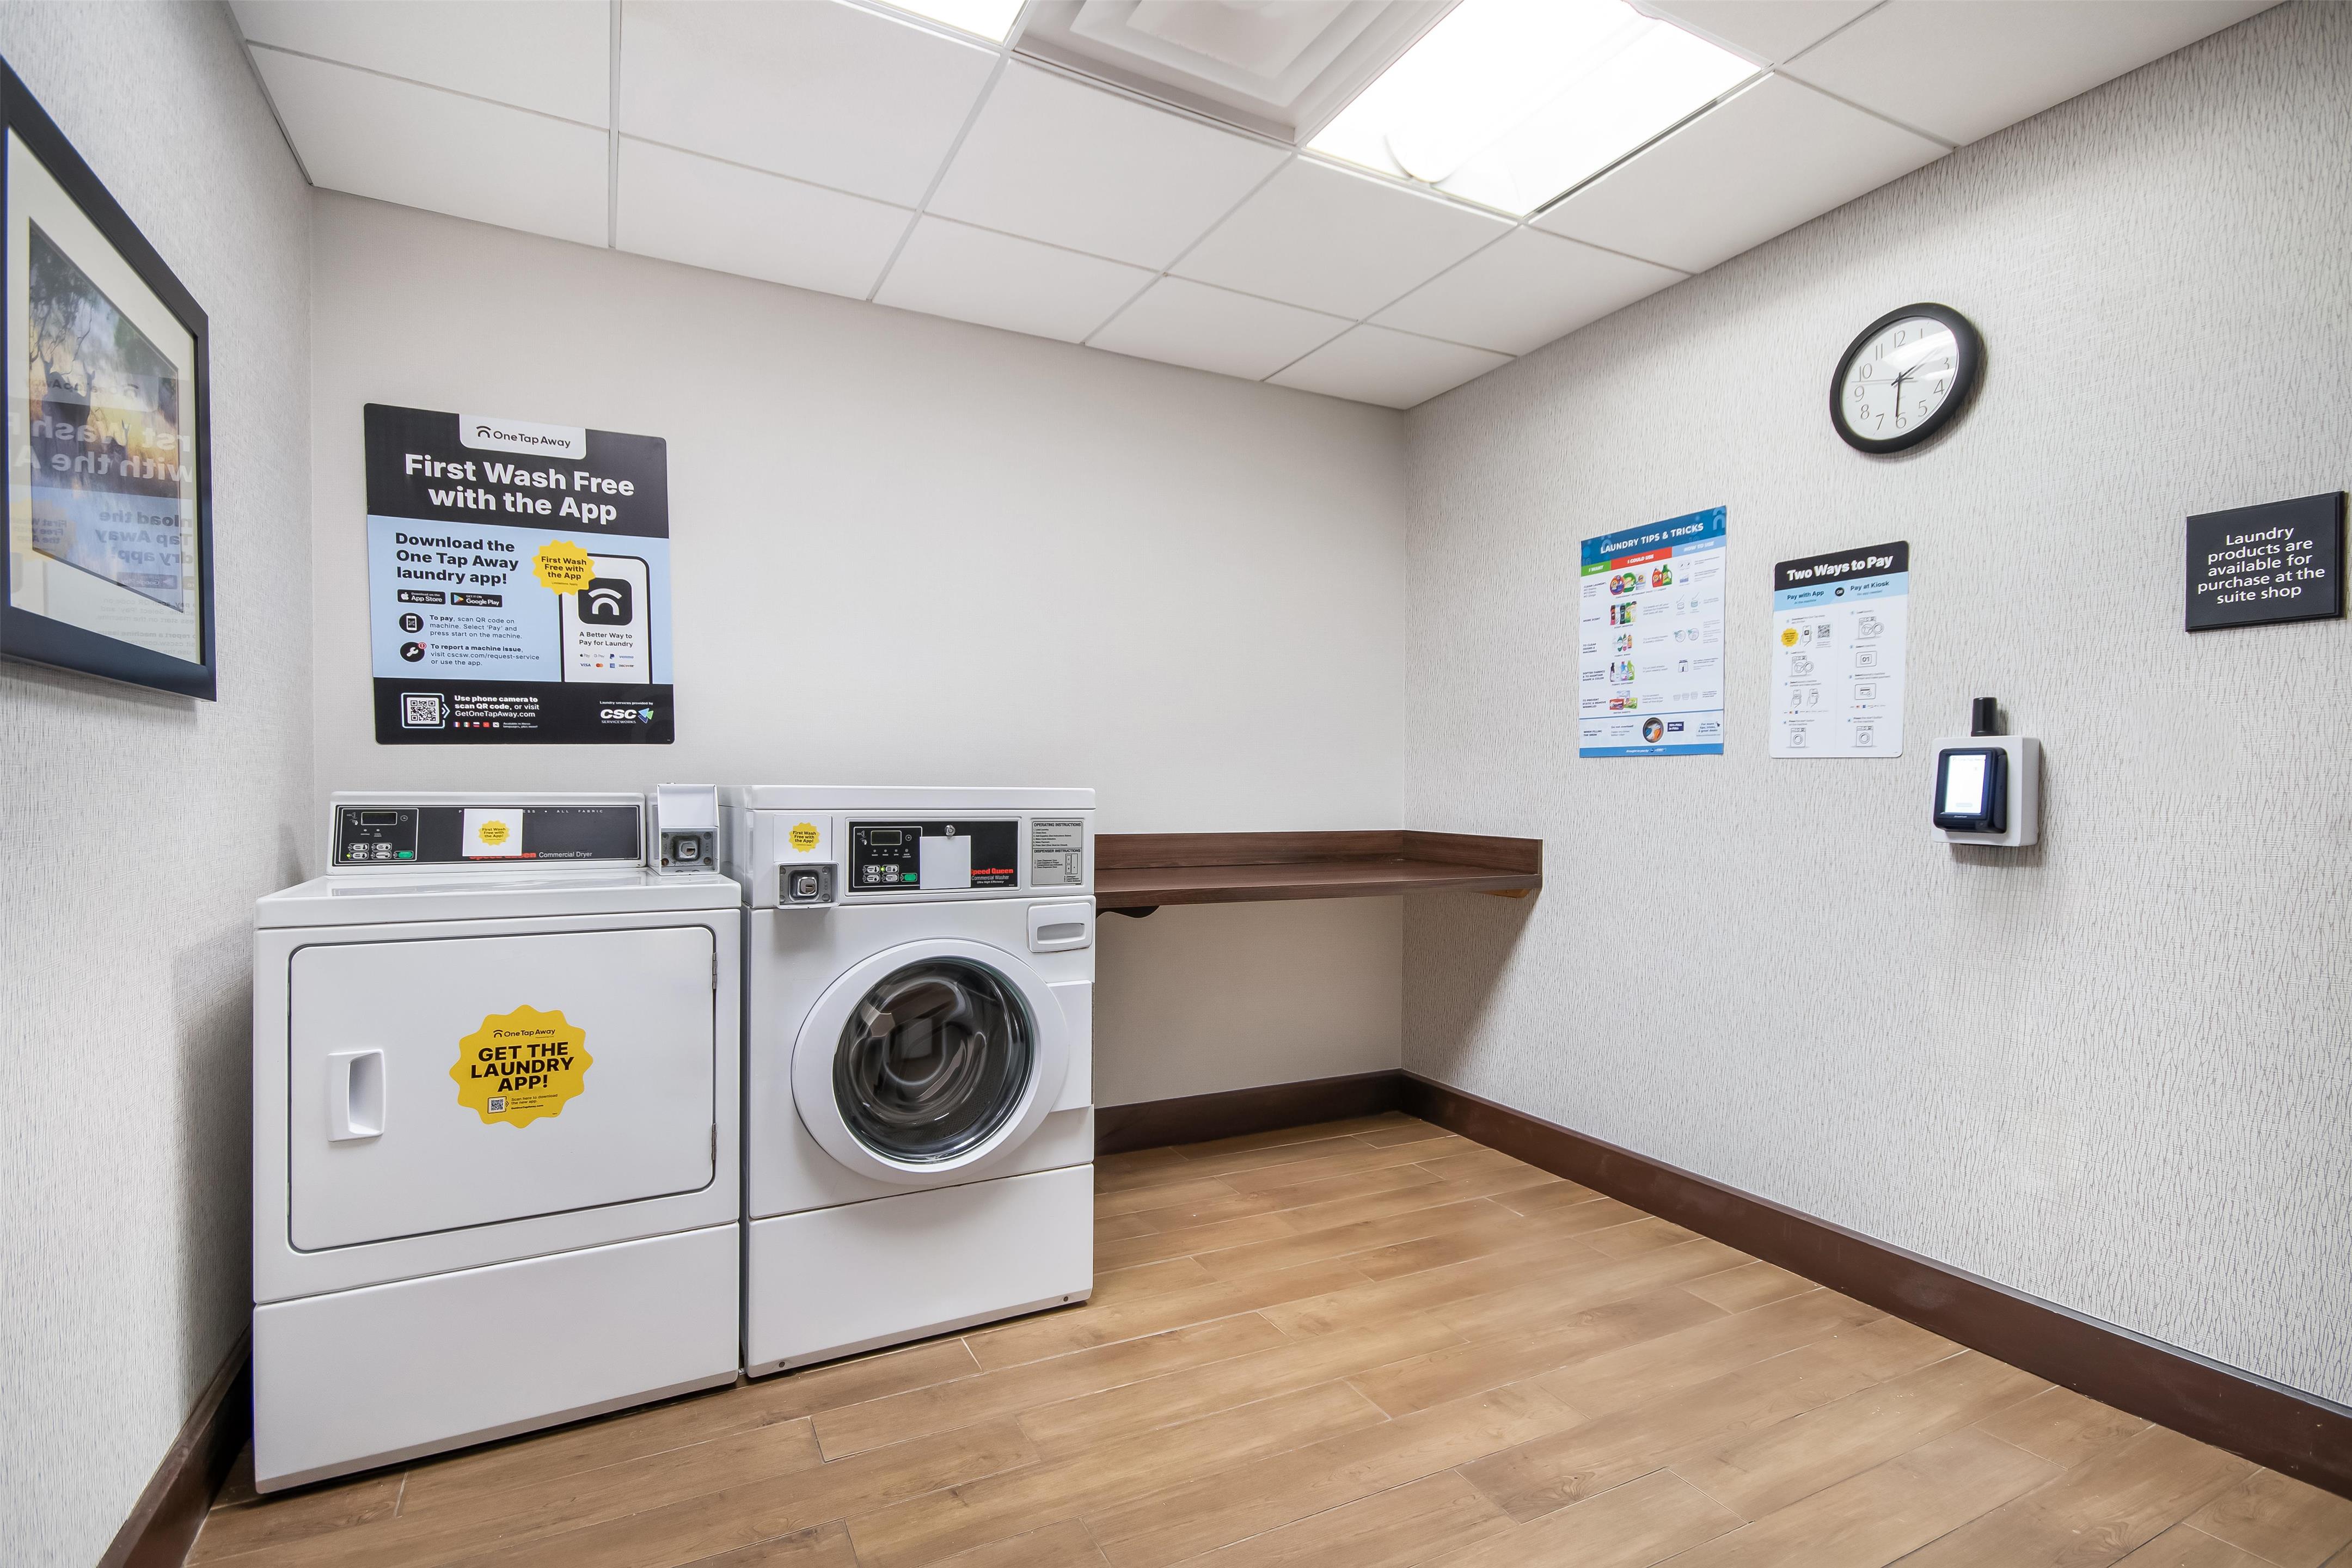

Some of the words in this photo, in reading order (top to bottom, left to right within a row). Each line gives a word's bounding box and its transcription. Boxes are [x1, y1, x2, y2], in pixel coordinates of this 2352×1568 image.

[1894, 330, 1906, 348] 12
[1875, 343, 1883, 361] 11
[1859, 363, 1872, 382] 10
[1854, 385, 1865, 402] 9
[1933, 379, 1945, 395] 4
[1860, 404, 1870, 419] 8
[1918, 399, 1928, 417] 5
[1875, 413, 1884, 431] 7
[1895, 412, 1907, 429] 6
[493, 431, 518, 441] One
[518, 433, 539, 445] Tap
[541, 436, 571, 449] Away
[406, 454, 476, 481] First
[483, 462, 566, 489] Wash
[574, 471, 634, 496] Free
[428, 486, 496, 510] with
[503, 492, 552, 514] the
[559, 497, 617, 525] App
[396, 532, 483, 550] Download
[487, 540, 514, 552] the
[1601, 538, 1639, 554] LAUNDRY
[1640, 533, 1660, 544] TIPS
[1662, 531, 1668, 540] &
[1670, 523, 1704, 537] TRICKS
[2226, 526, 2294, 546] Laundry
[396, 549, 432, 563] One
[436, 552, 468, 568] Tap
[472, 555, 519, 571] Away
[2208, 543, 2281, 565] products
[2285, 540, 2313, 552] are
[1787, 569, 1812, 581] Two
[1814, 563, 1849, 577] Ways
[1851, 560, 1865, 571] to
[1867, 556, 1894, 568] Pay
[2208, 557, 2281, 577] available
[2286, 554, 2313, 567] for
[397, 566, 465, 584] laundry
[470, 573, 506, 586] app!
[564, 572, 581, 580] App
[2197, 574, 2270, 595] purchase
[2275, 571, 2293, 583] at
[2295, 567, 2325, 580] the
[2216, 590, 2256, 604] suite
[2261, 586, 2302, 599] shop
[601, 709, 637, 719] CSC
[478, 1045, 522, 1062] GET
[526, 1042, 568, 1058] THE
[470, 1056, 575, 1079] LAUNDRY
[497, 1074, 548, 1092] APP!
